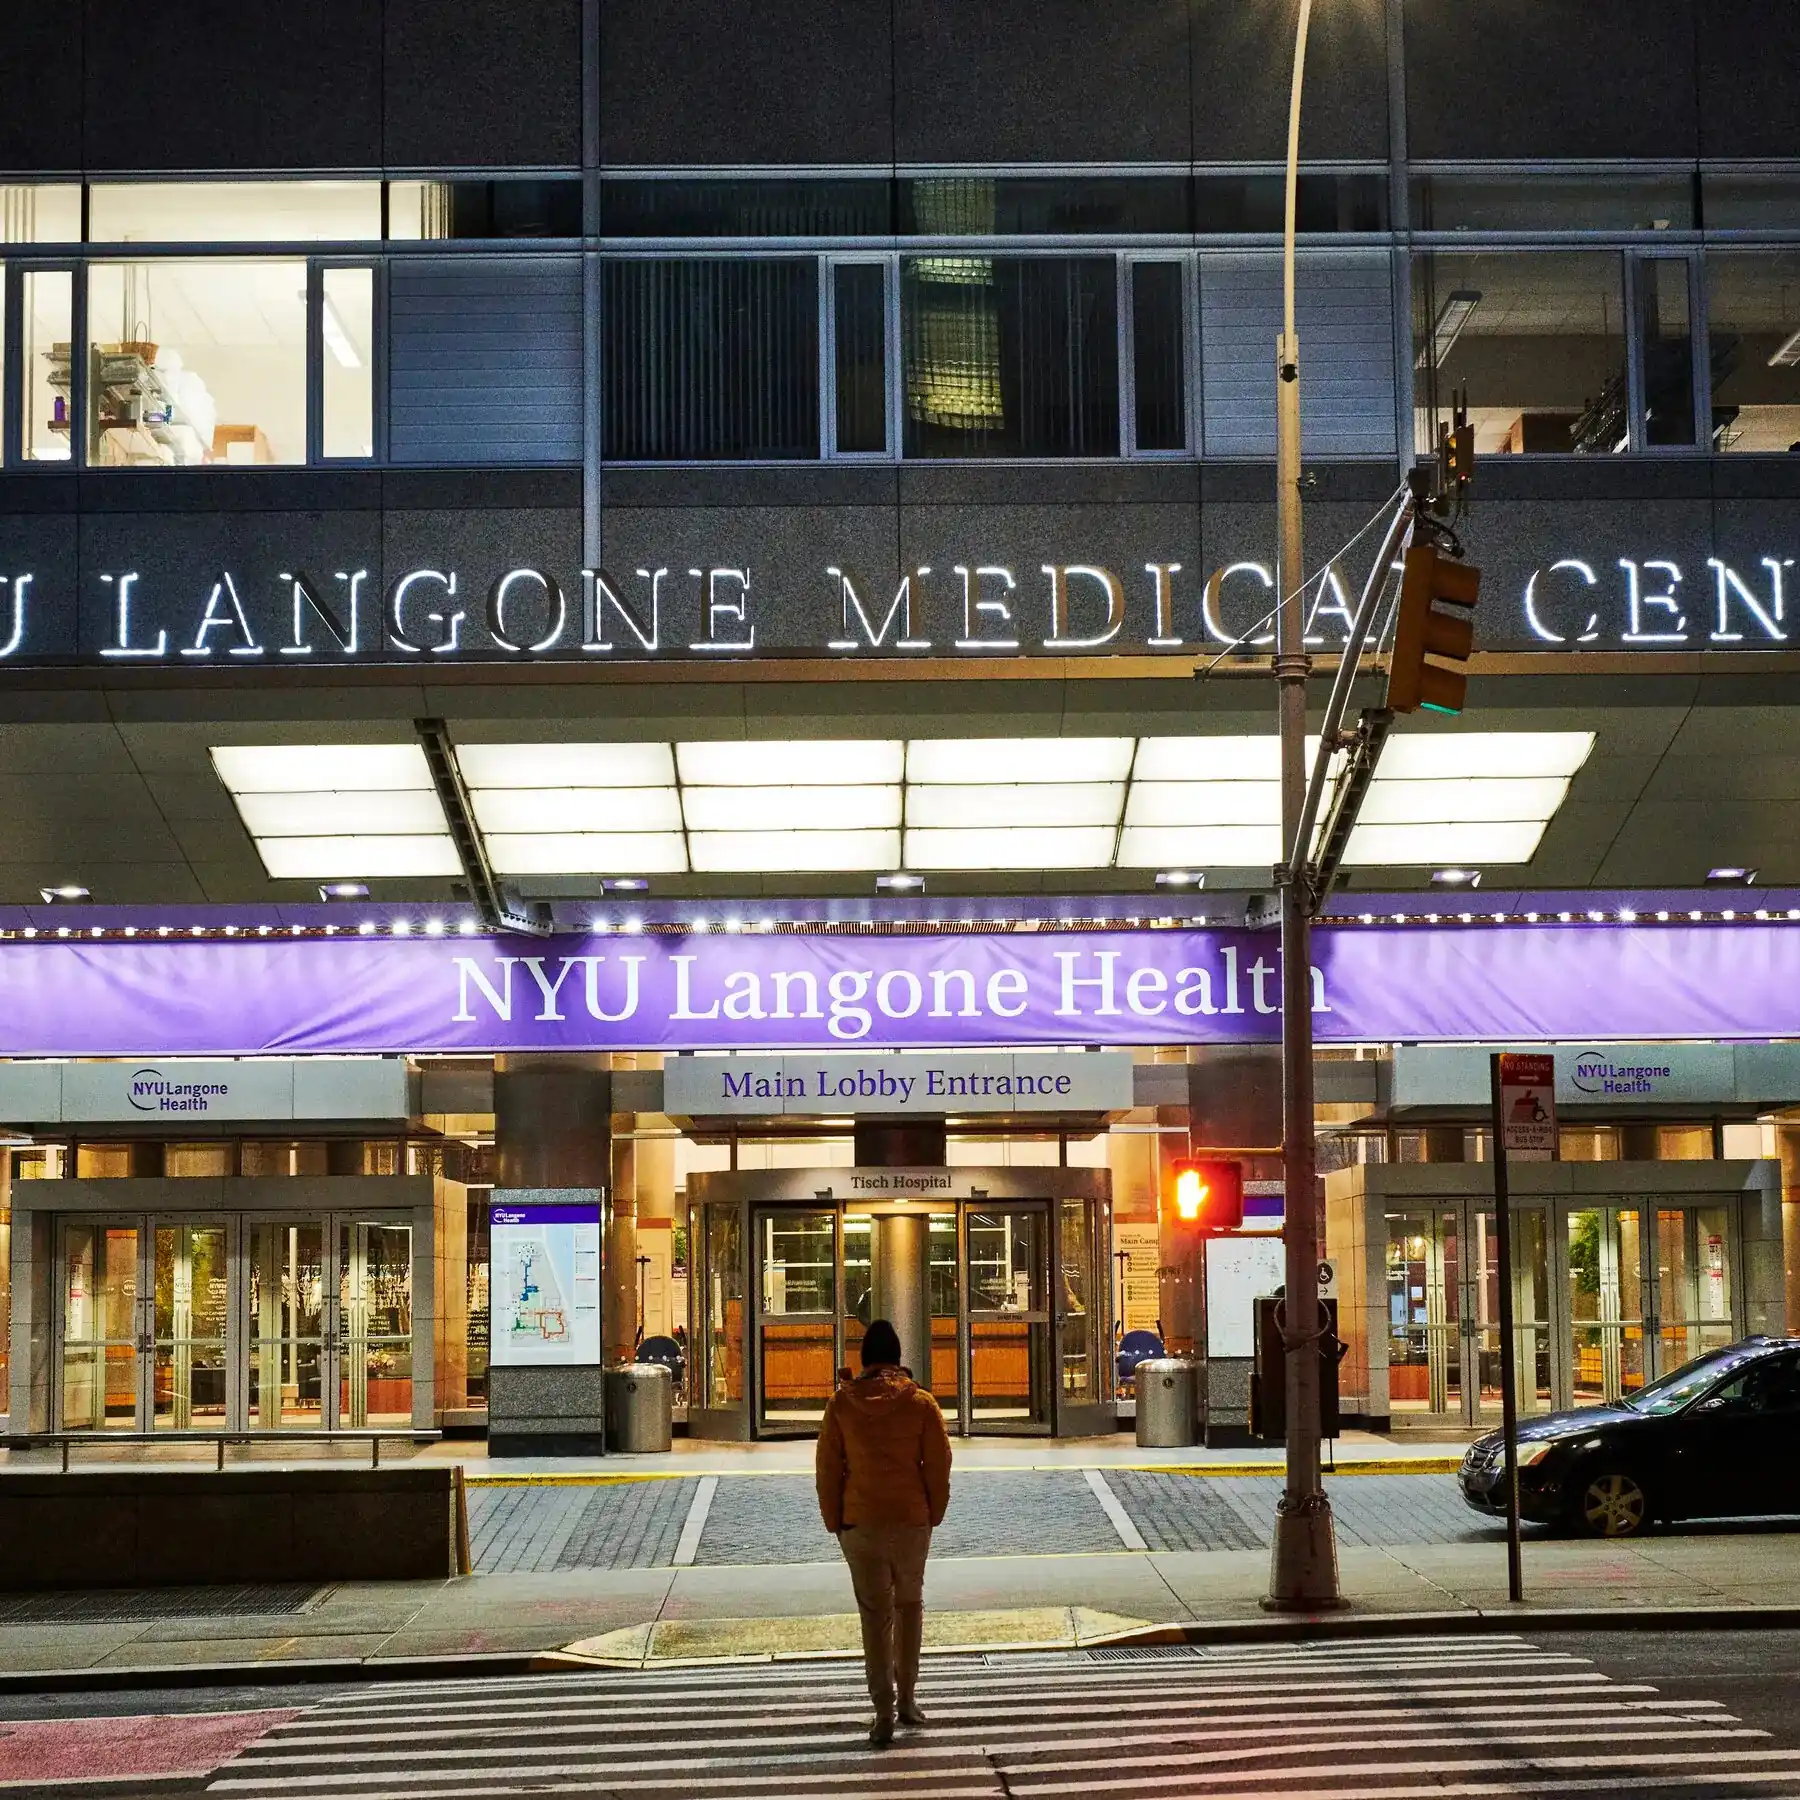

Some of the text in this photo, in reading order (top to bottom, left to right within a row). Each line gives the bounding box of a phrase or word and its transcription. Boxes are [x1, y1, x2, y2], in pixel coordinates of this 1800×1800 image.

[100, 566, 754, 655] LANGONE
[827, 560, 1405, 648] MEDICA
[1524, 556, 1796, 642] CEN
[451, 954, 647, 1023] NYU
[668, 953, 1029, 1040] Langone
[1516, 1060, 1550, 1072] STANDING
[1577, 1064, 1671, 1080] NYU Langone
[133, 1081, 229, 1098] NYU Langone
[721, 1069, 1072, 1104] Main Lobby Entrance
[1604, 1080, 1651, 1093] Health
[160, 1097, 208, 1111] Health
[850, 1175, 952, 1192] Tisch Hospital
